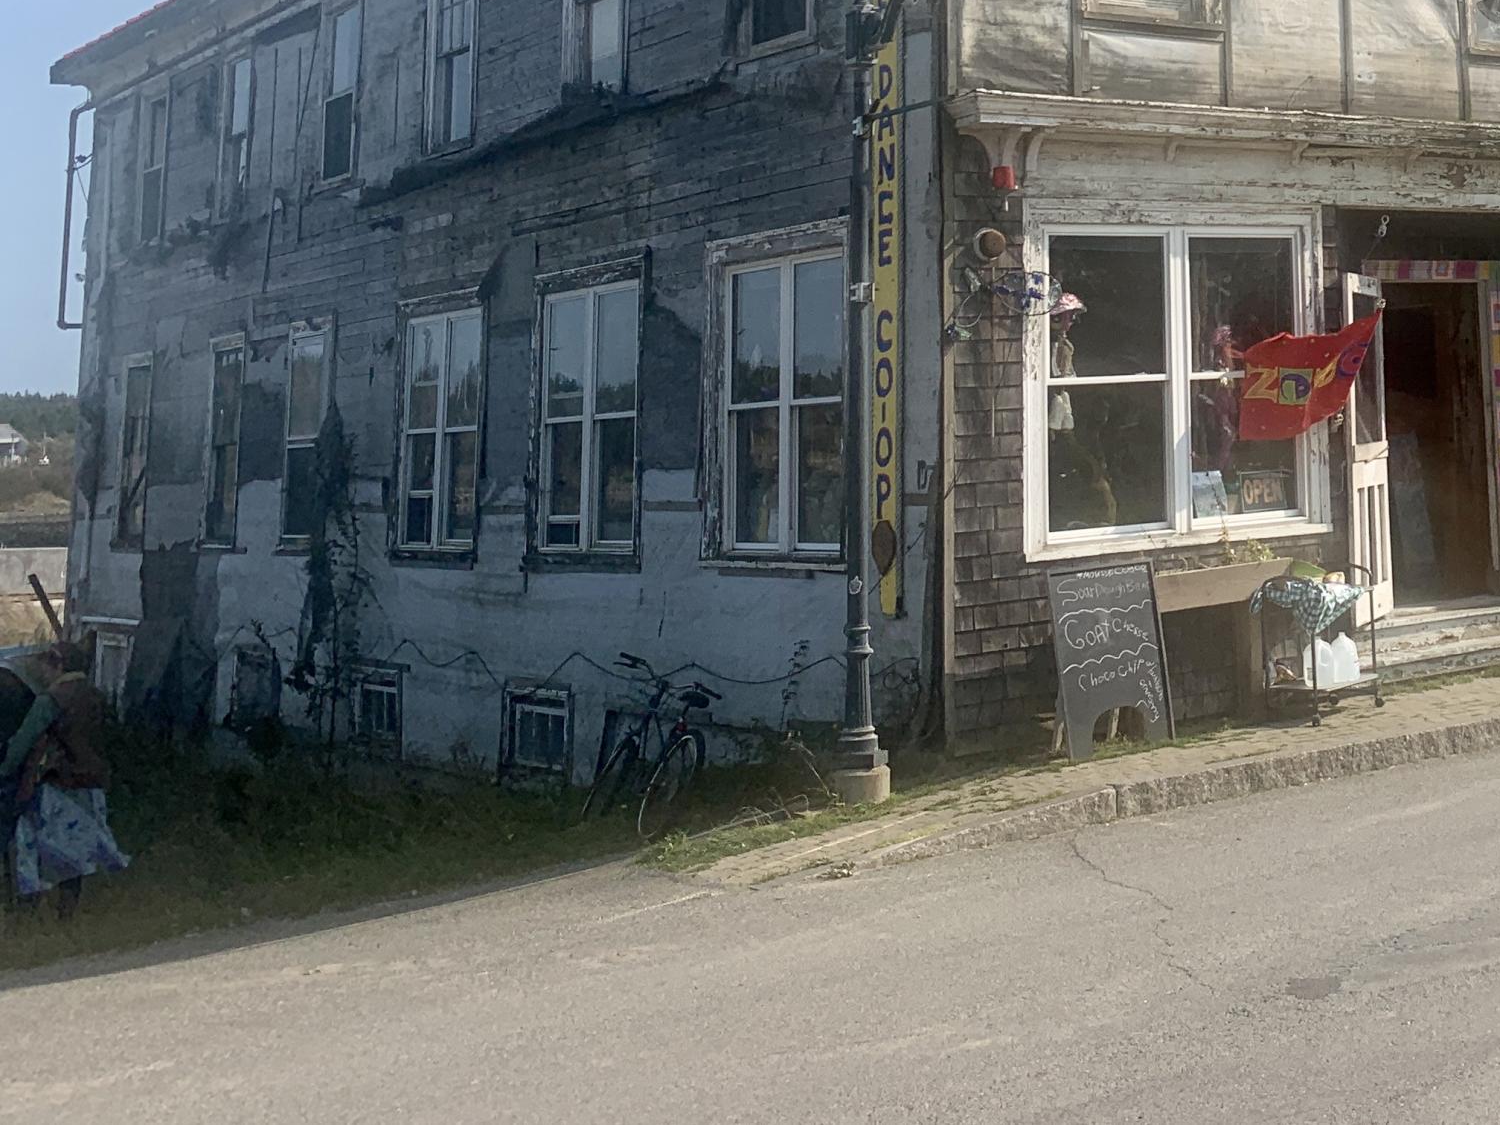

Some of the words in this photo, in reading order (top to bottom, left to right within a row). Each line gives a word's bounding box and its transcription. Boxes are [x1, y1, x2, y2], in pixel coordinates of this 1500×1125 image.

[877, 63, 895, 269] DANCE
[875, 308, 894, 521] CO-OP
[1242, 477, 1283, 505] OPEN
